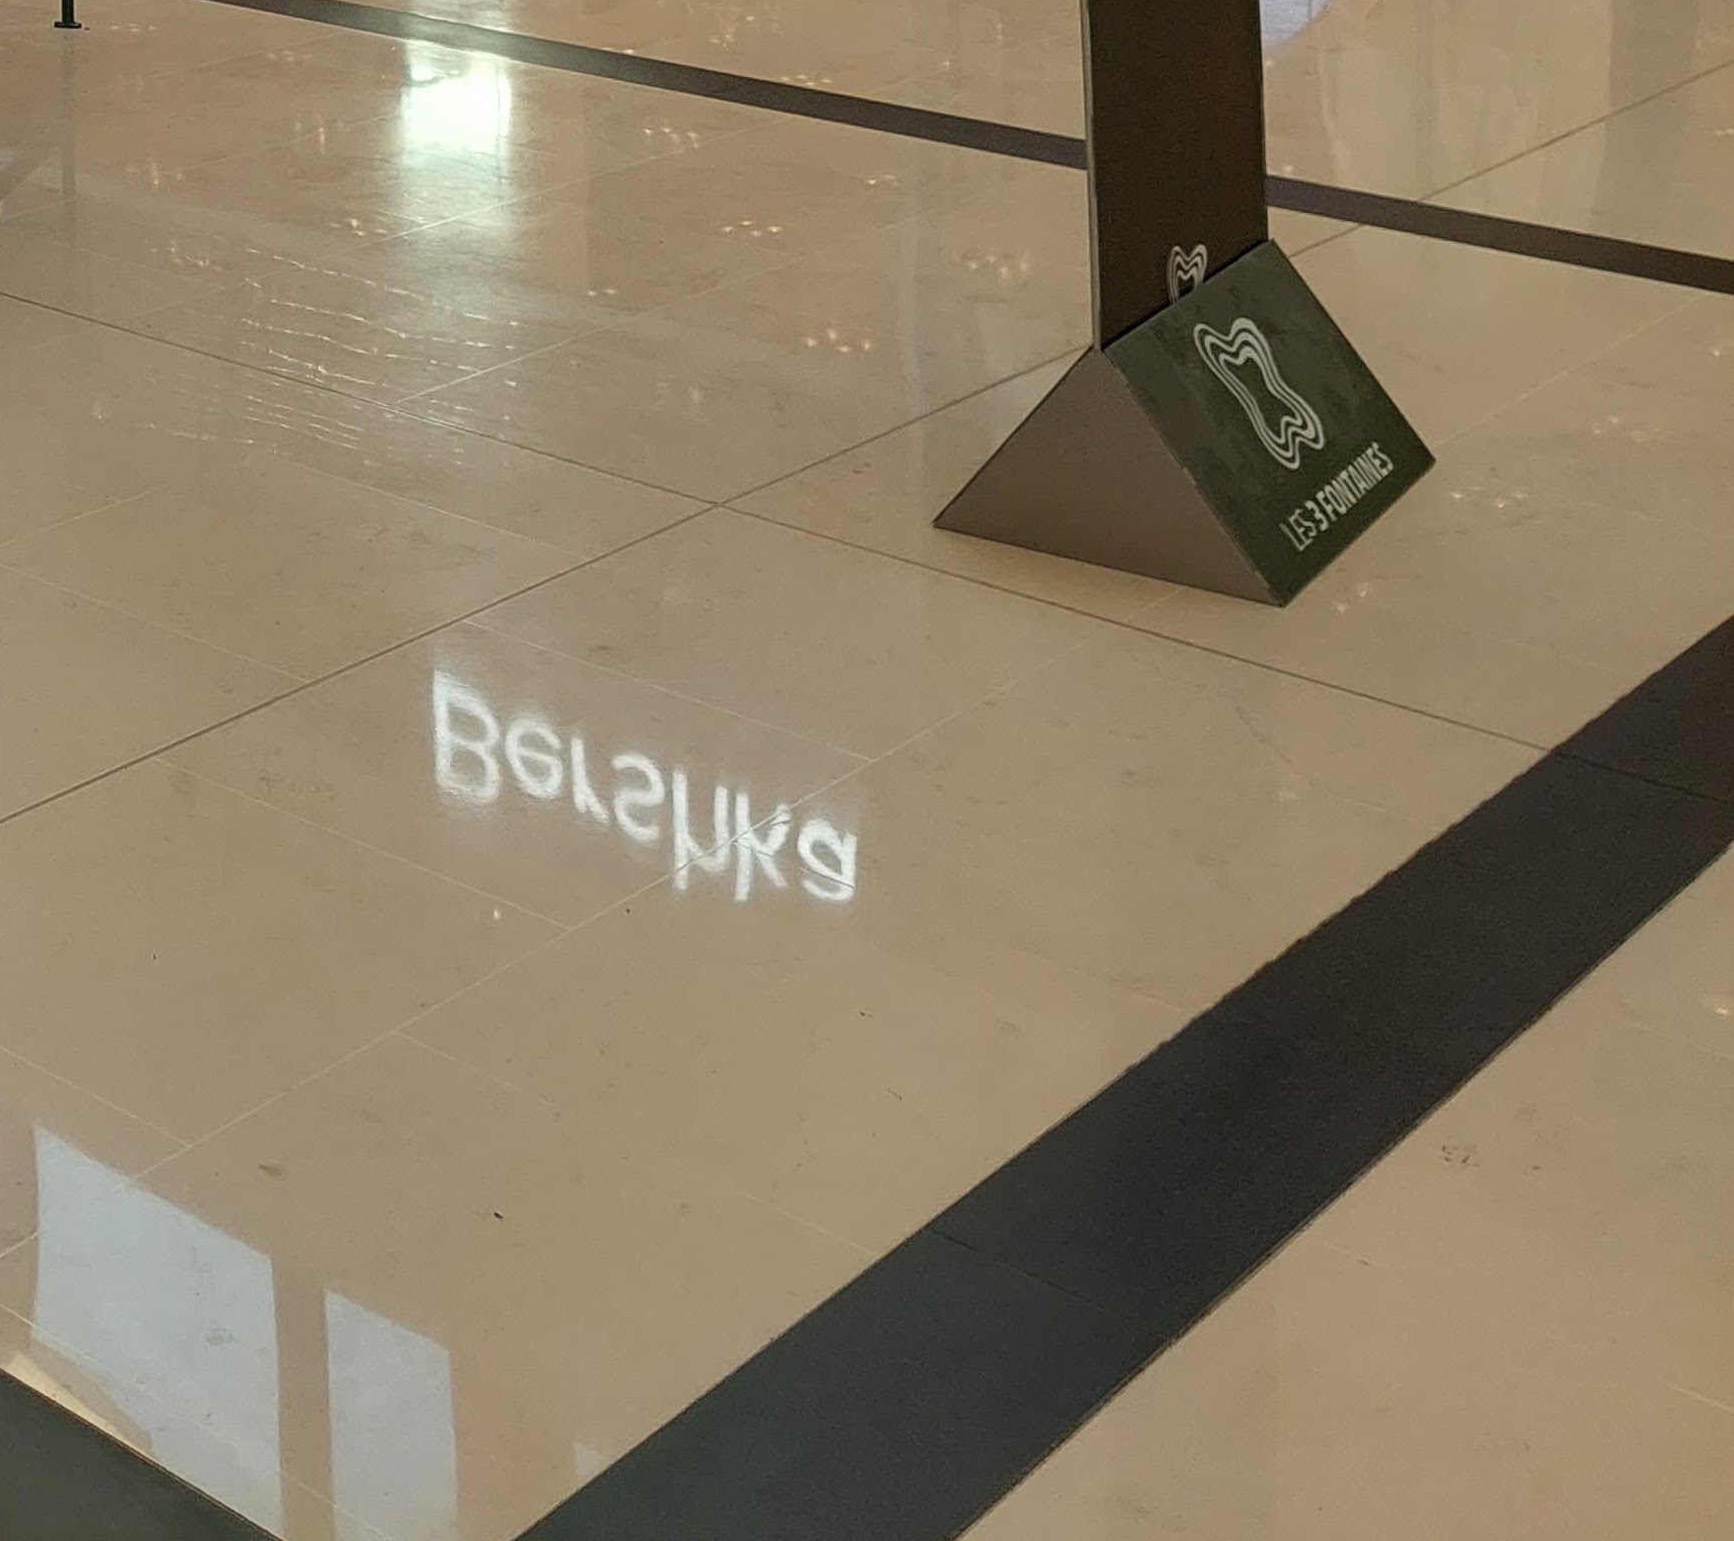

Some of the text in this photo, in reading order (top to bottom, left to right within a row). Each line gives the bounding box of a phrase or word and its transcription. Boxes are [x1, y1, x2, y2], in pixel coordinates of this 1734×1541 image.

[1278, 441, 1395, 552] LES 3 FONTAINES
